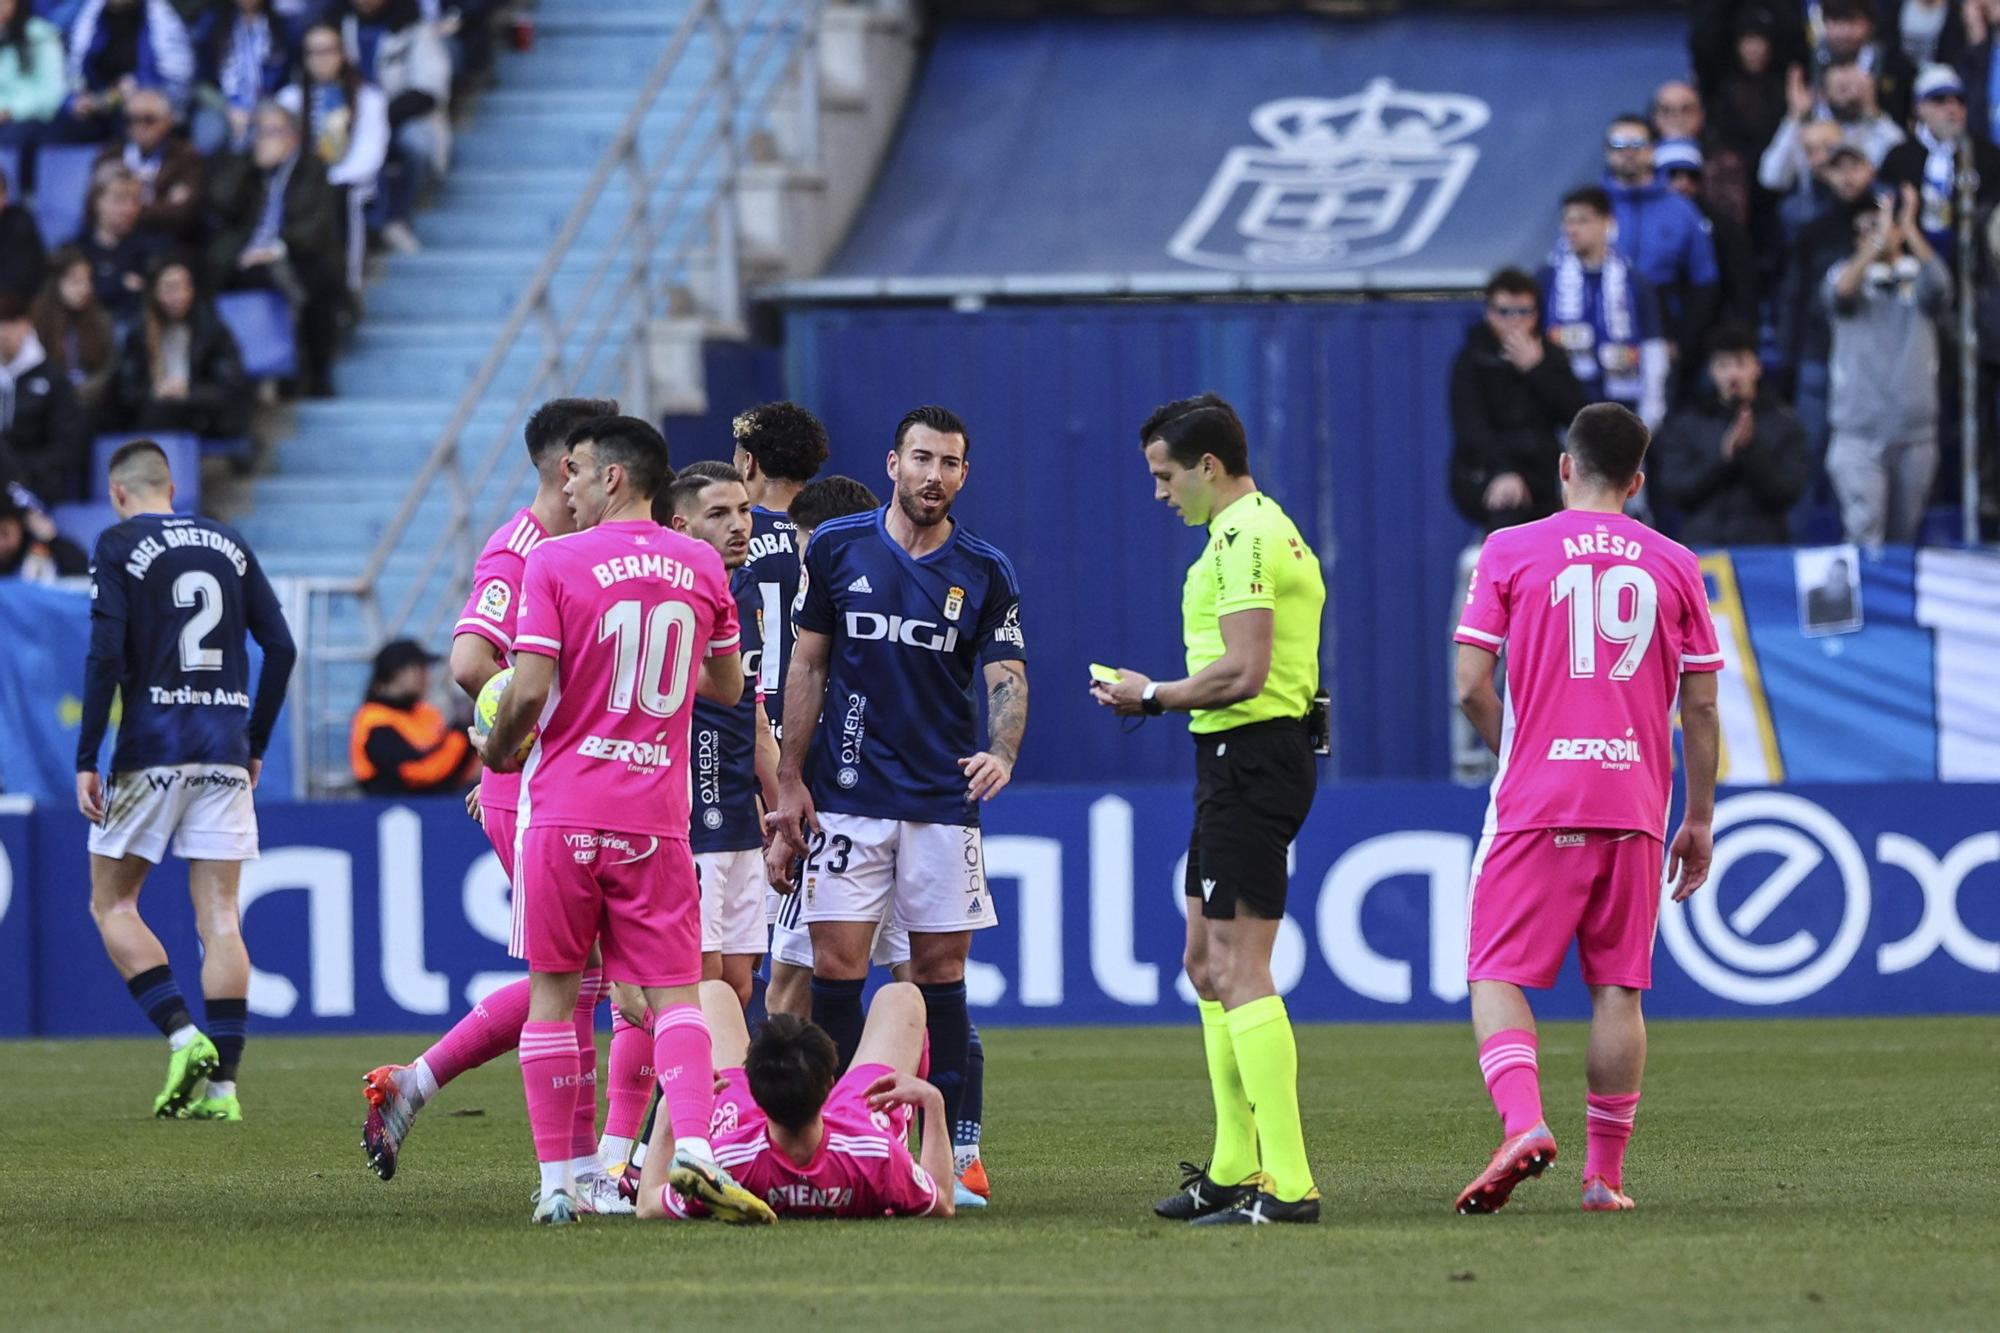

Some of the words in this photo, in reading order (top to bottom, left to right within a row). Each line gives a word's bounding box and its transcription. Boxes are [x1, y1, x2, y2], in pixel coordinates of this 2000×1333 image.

[125, 535, 166, 581] ABEL
[162, 527, 247, 577] BRETONES
[1563, 532, 1642, 561] ARESO
[591, 553, 695, 591] BERMEJO
[172, 571, 223, 672] 2
[845, 611, 959, 653] DIGI
[1551, 564, 1657, 681] 19
[598, 600, 696, 719] 10
[150, 685, 212, 705] Tartiere
[841, 693, 860, 764] OVIEDO
[699, 730, 714, 804] OVIEDO
[807, 831, 853, 876] 23
[768, 1184, 853, 1207] ATIENZA
